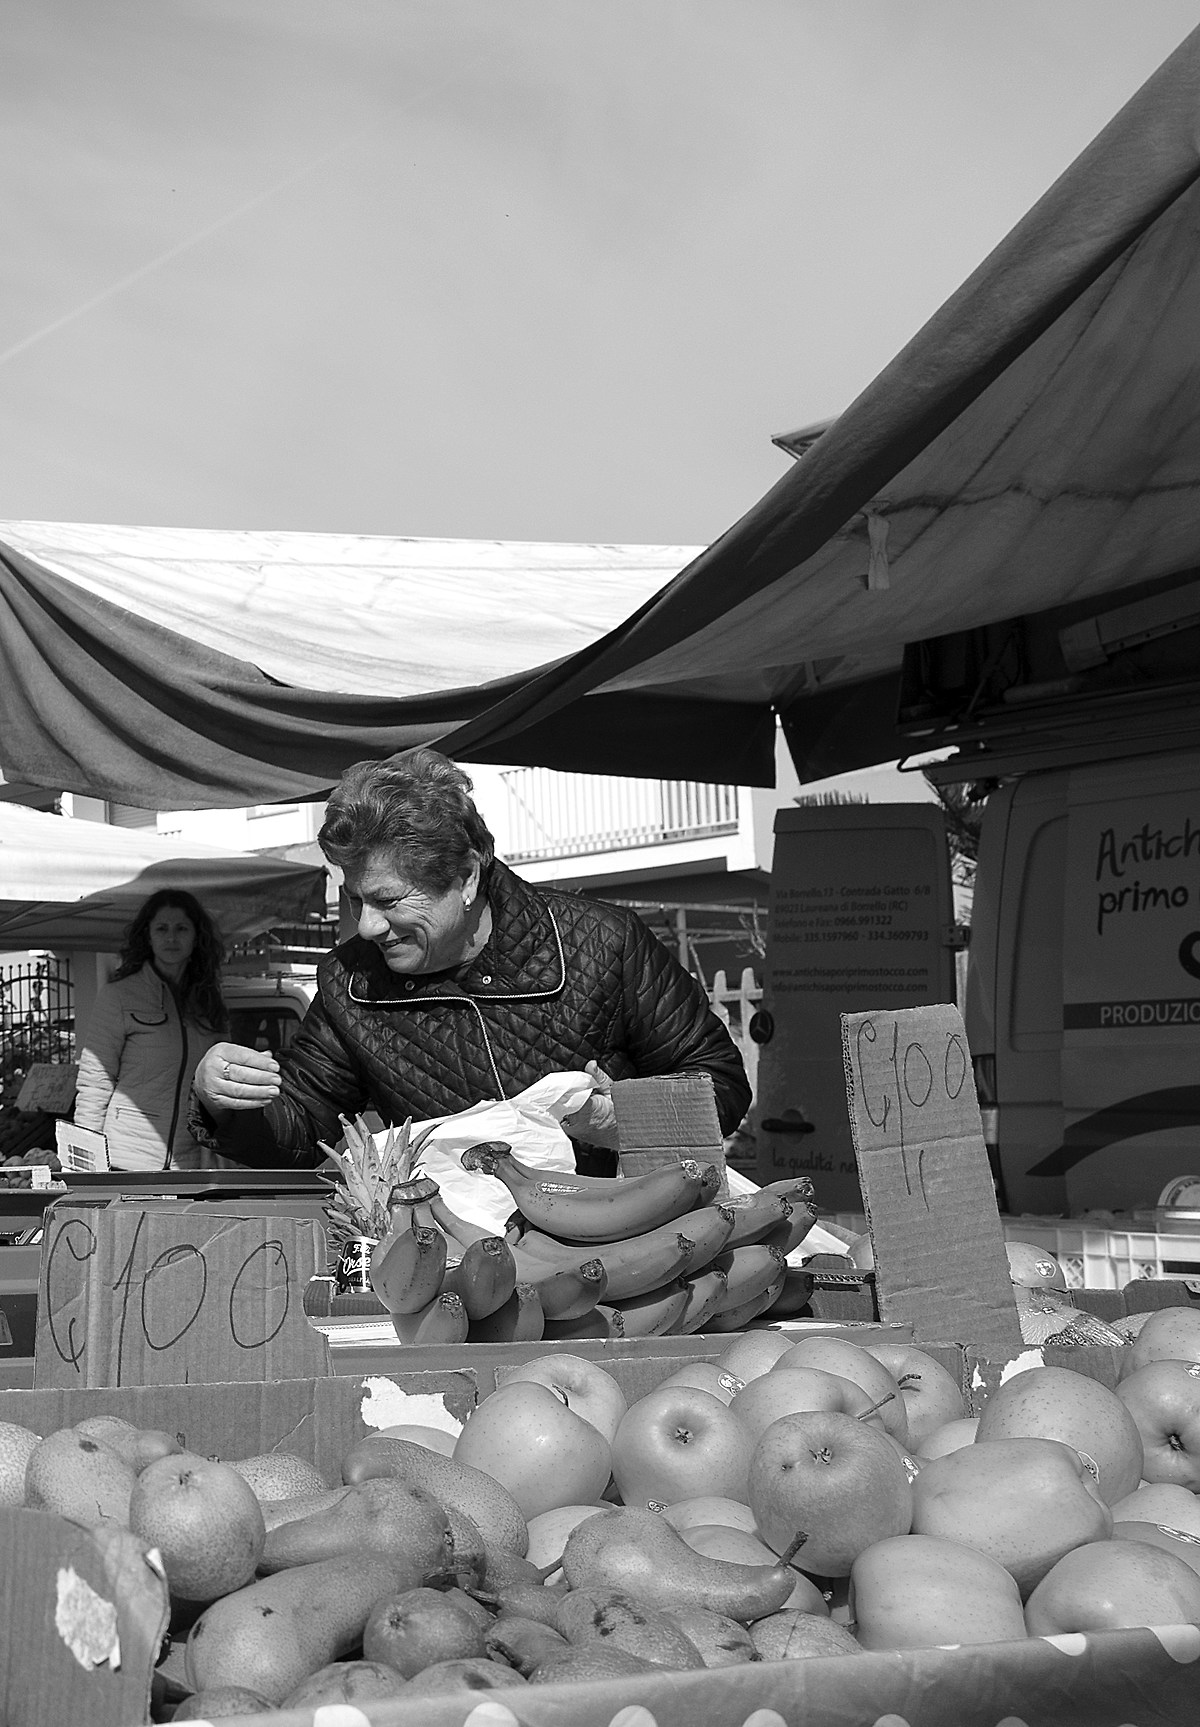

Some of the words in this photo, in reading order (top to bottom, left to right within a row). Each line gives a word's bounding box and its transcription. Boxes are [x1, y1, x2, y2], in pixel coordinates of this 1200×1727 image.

[1096, 817, 1200, 882] Antich
[840, 886, 881, 897] Contrada
[883, 885, 910, 896] Gatto
[914, 885, 931, 896] 6/8
[840, 901, 848, 912] di
[850, 901, 887, 912] Borrello
[888, 901, 909, 912] (RC)
[1097, 880, 1189, 936] primo
[834, 915, 892, 926] 0966.991322
[867, 930, 929, 941] 334.3609793
[773, 1148, 786, 1167] la
